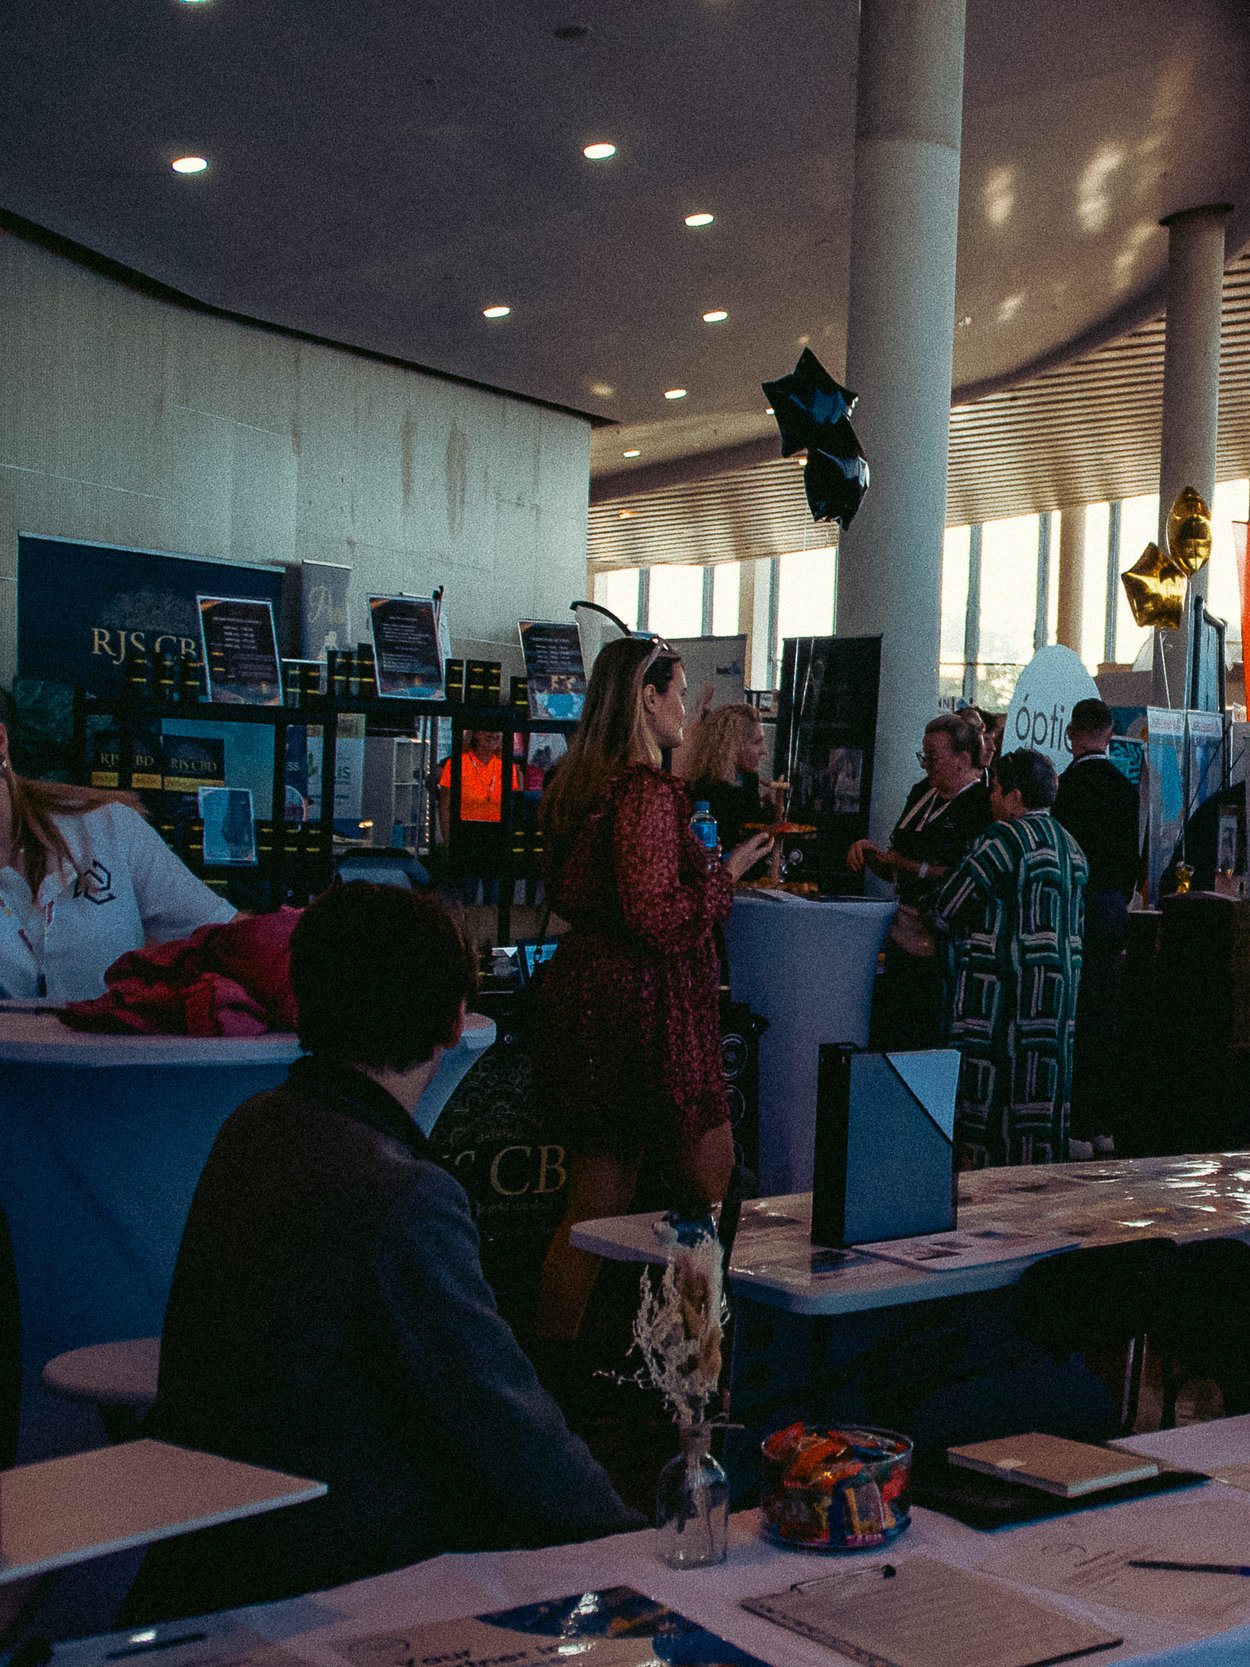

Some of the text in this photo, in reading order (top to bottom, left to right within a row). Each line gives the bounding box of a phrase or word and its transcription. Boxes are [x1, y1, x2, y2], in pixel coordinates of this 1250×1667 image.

[91, 627, 147, 665] RJS
[153, 634, 198, 660] CB
[490, 1144, 568, 1196] CB
